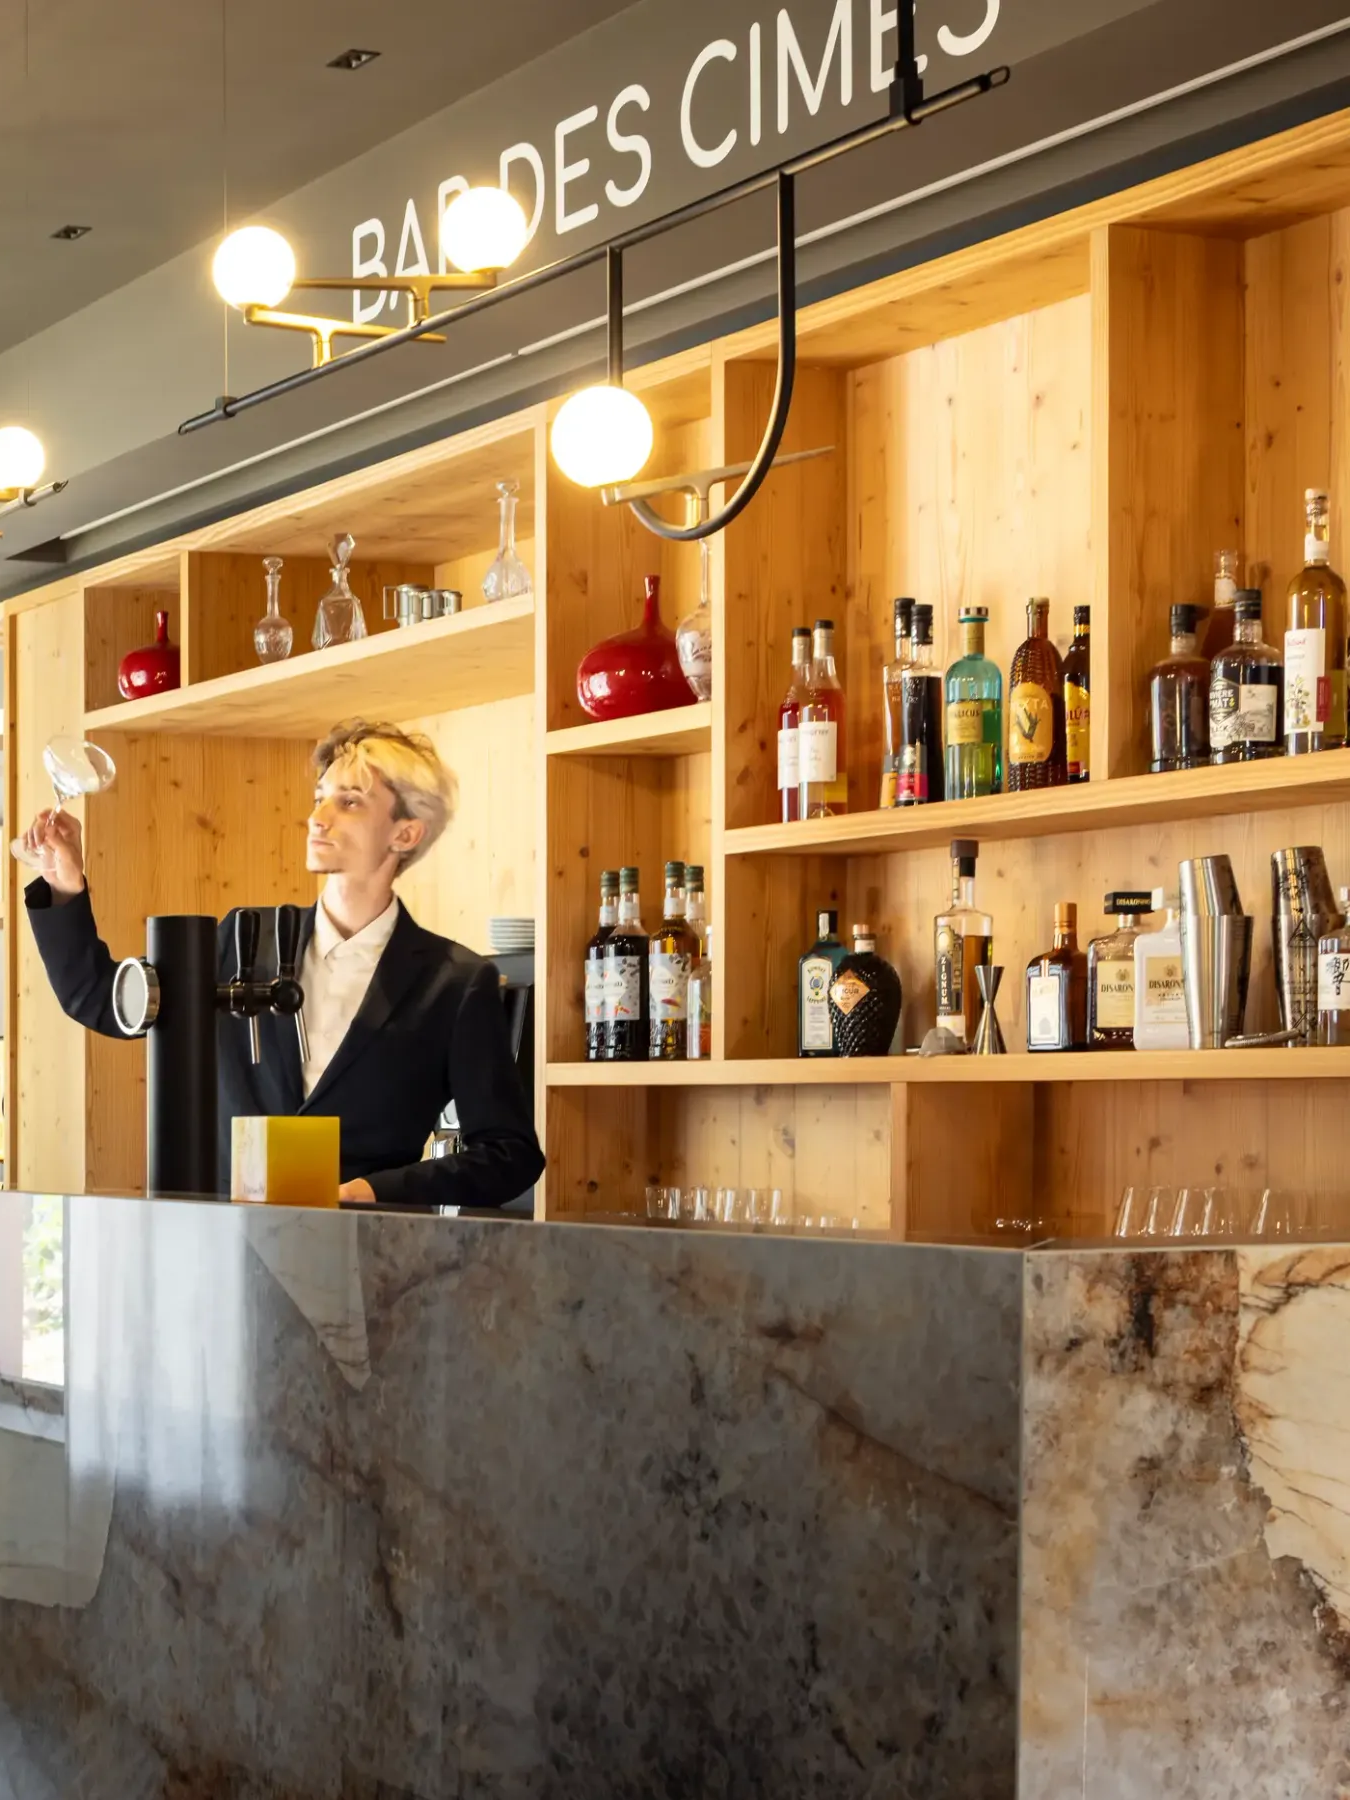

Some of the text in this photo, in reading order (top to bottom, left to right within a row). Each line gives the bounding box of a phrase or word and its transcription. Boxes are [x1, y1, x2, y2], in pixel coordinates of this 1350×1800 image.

[500, 84, 652, 248] DES
[940, 956, 949, 1005] ZIGNUM
[1101, 983, 1134, 994] DISARON
[1149, 979, 1184, 990] DISARON
